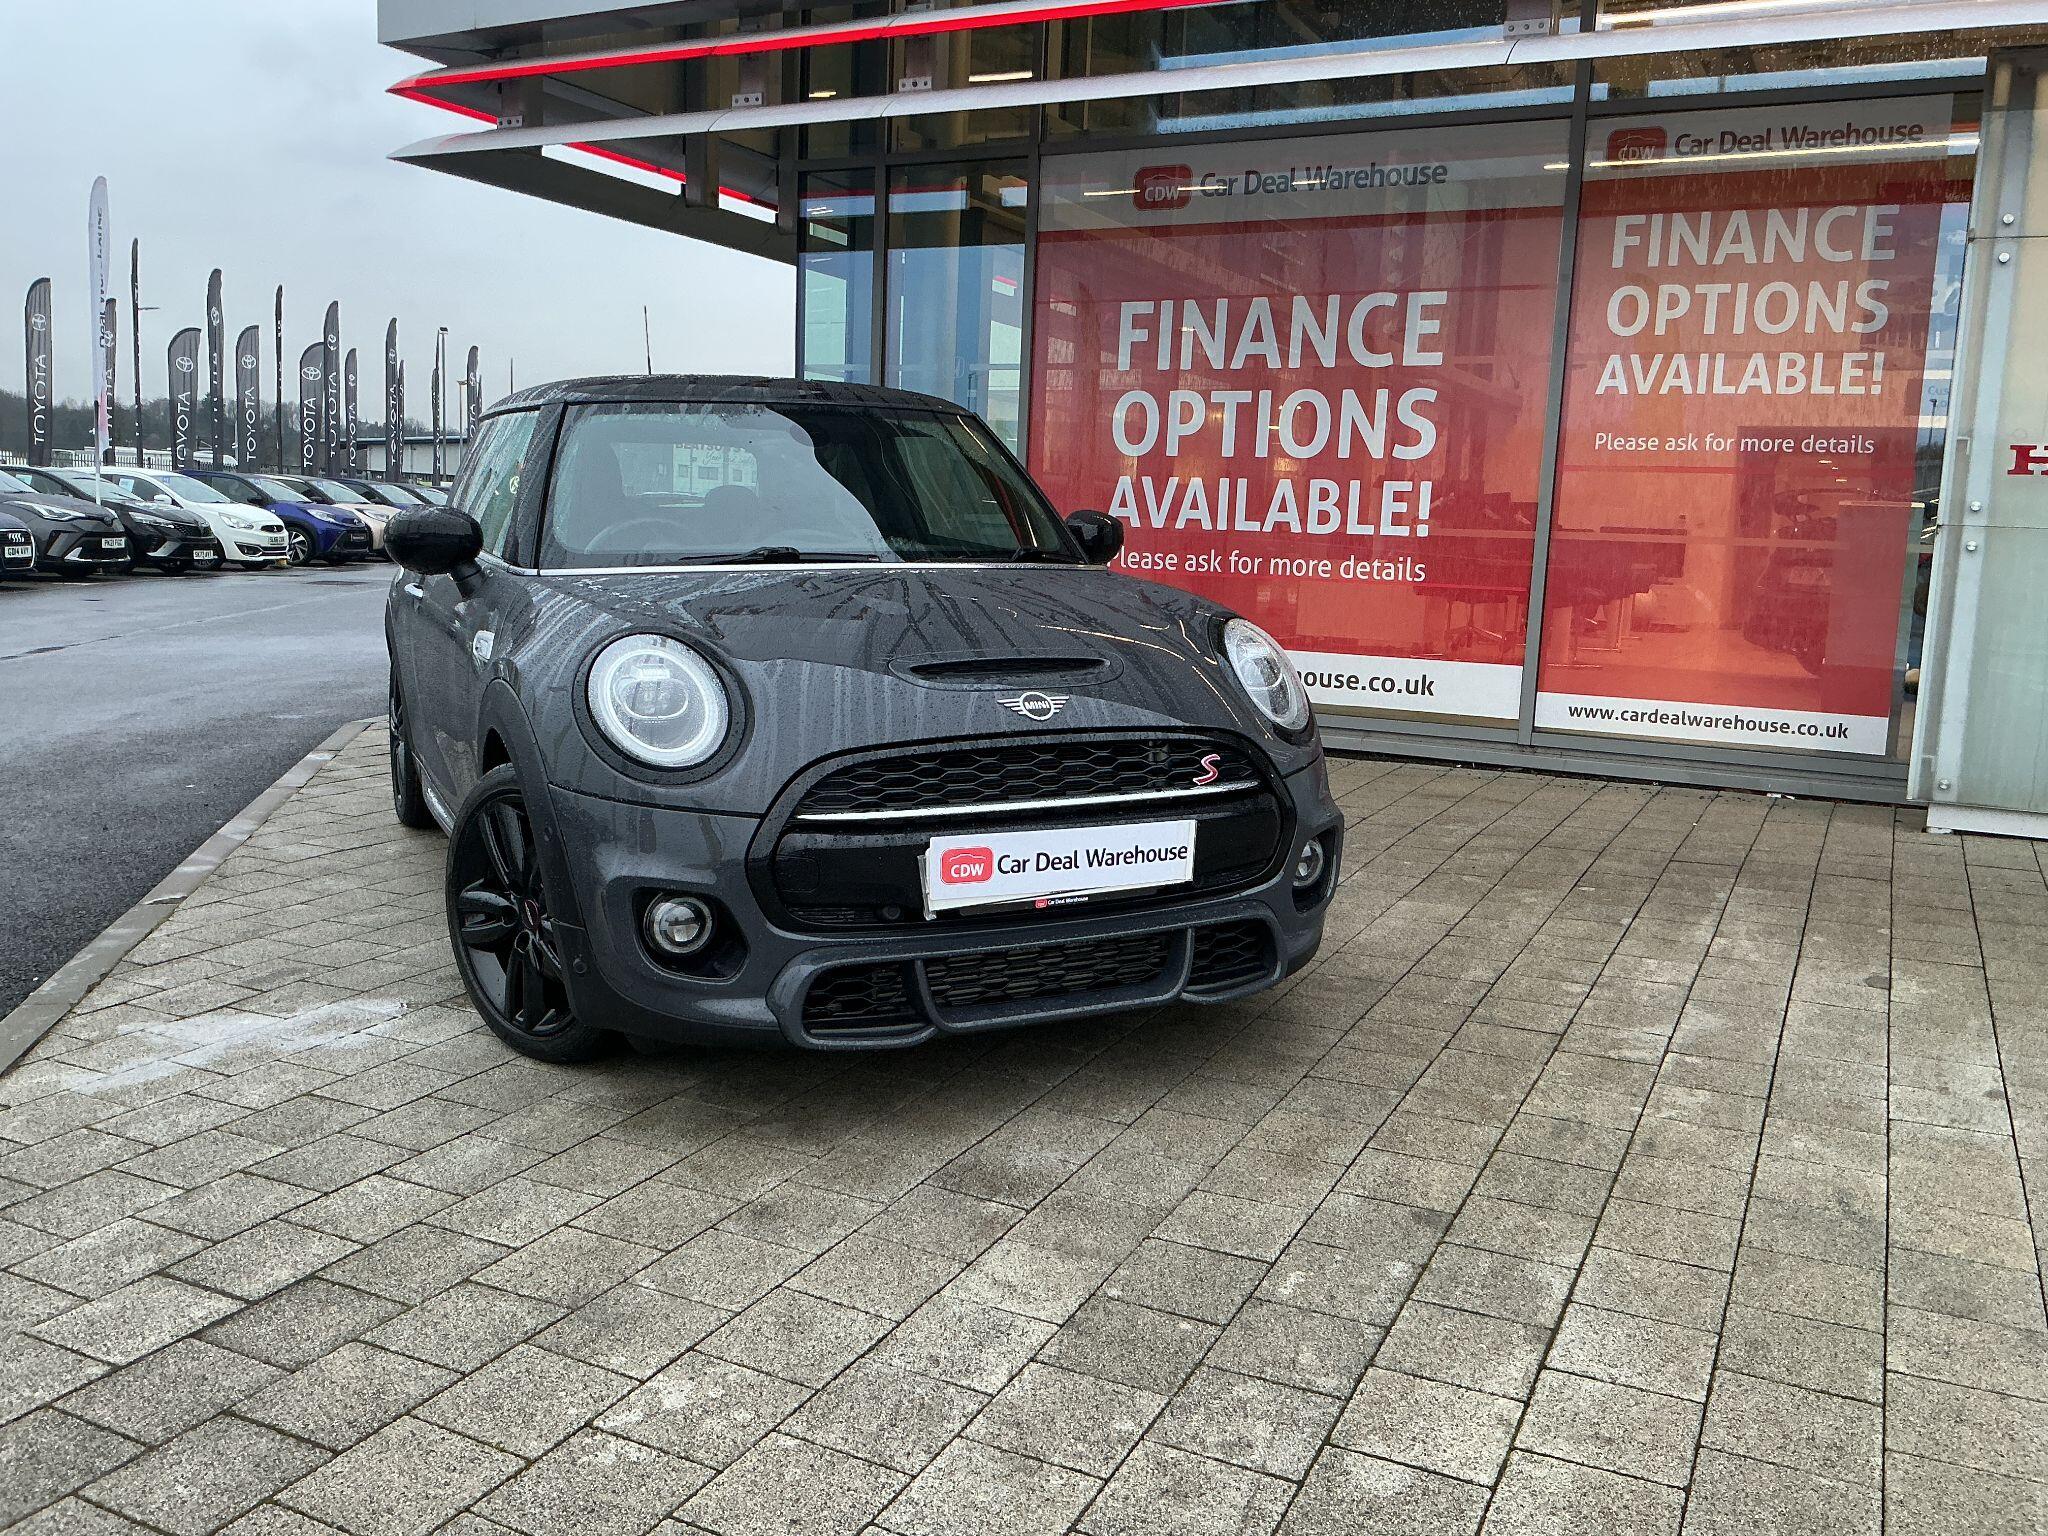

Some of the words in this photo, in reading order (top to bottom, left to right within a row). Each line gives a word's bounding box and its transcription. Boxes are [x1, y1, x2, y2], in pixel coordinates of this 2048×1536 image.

[1674, 132, 1714, 157] Car
[1719, 127, 1773, 154] Deal
[1781, 122, 1924, 149] Warehouse
[1144, 184, 1179, 203] CDW
[1200, 171, 1238, 198] Car
[1244, 167, 1297, 196] Deal
[1305, 162, 1448, 192] Warehouse
[1610, 204, 1900, 268] FINANCE
[1605, 279, 1891, 336] OPTIONS
[1116, 290, 1449, 371] FINANCE
[1595, 350, 1885, 395] AVAILABLE!
[34, 354, 47, 445] TOYOTA
[328, 371, 338, 458] TOYOTA
[245, 386, 255, 463] TOYOTA
[303, 397, 317, 468] TOYOTA
[389, 384, 397, 467] TOYOTA
[1111, 387, 1438, 460] OPTIONS
[1594, 432, 1659, 451] Please
[1665, 433, 1698, 451] ask
[1704, 433, 1735, 452] for
[1740, 438, 1795, 453] more
[1801, 434, 1875, 454] details
[1106, 476, 1433, 538] AVAILABLE!
[1184, 549, 1223, 573] ask
[1229, 550, 1263, 575] for
[1269, 558, 1332, 578] more
[1339, 556, 1427, 582] details
[1024, 700, 1051, 710] MINI
[1568, 703, 1849, 740] www.cardealwarehouse.co.uk
[1193, 754, 1220, 784] S
[950, 863, 984, 878] CDW
[997, 854, 1030, 875] Car
[1035, 850, 1080, 872] Deal
[1086, 845, 1188, 868] Warehouse
